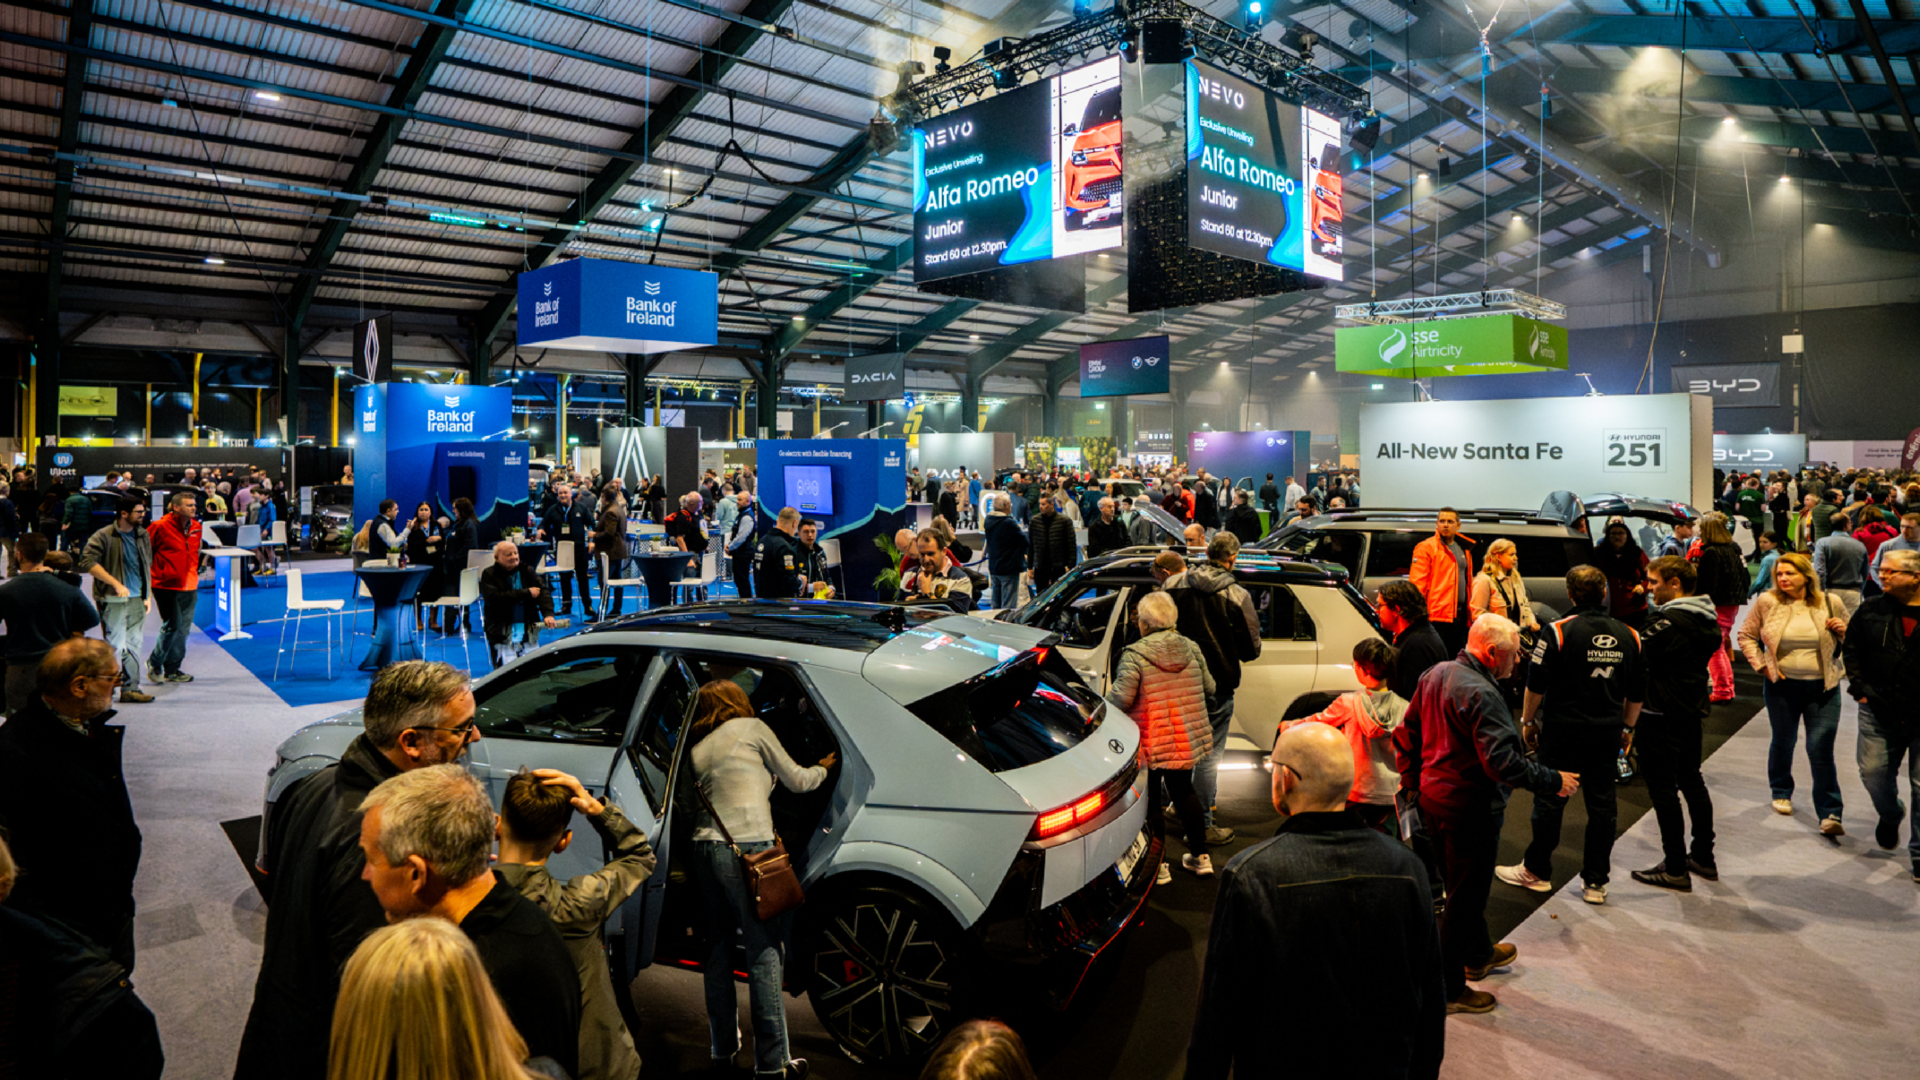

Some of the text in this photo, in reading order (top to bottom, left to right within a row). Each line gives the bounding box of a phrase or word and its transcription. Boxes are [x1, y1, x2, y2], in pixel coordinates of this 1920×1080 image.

[1199, 76, 1245, 109] NEVO
[925, 121, 973, 149] NEVO
[1200, 117, 1255, 147] Exclusive Unveiling
[925, 153, 984, 177] Exclusive Unveiling
[1201, 145, 1294, 195] Alfa Romeo
[925, 167, 1039, 212] Alfa Romeo
[1201, 185, 1238, 210] Junior
[925, 220, 964, 240] Junior
[1201, 218, 1225, 235] Stand
[1225, 224, 1235, 238] 60
[1235, 228, 1244, 240] at
[925, 250, 949, 265] Stand
[949, 249, 960, 260] 60
[960, 246, 970, 257] at
[535, 297, 560, 314] Bank of
[626, 297, 677, 313] Bank of
[535, 312, 559, 327] Ireland
[626, 310, 675, 327] Ireland
[1411, 330, 1439, 344] sse
[1410, 344, 1463, 359] Airtricity
[851, 372, 896, 384] DACIA
[1689, 379, 1761, 393] BYD
[428, 410, 476, 422] Bank of
[428, 421, 473, 432] Ireland
[1376, 442, 1563, 460] All-New Santa Fe
[1607, 443, 1661, 467] 251
[1713, 448, 1774, 461] BYD
[1587, 650, 1624, 659] HYUNDAI
